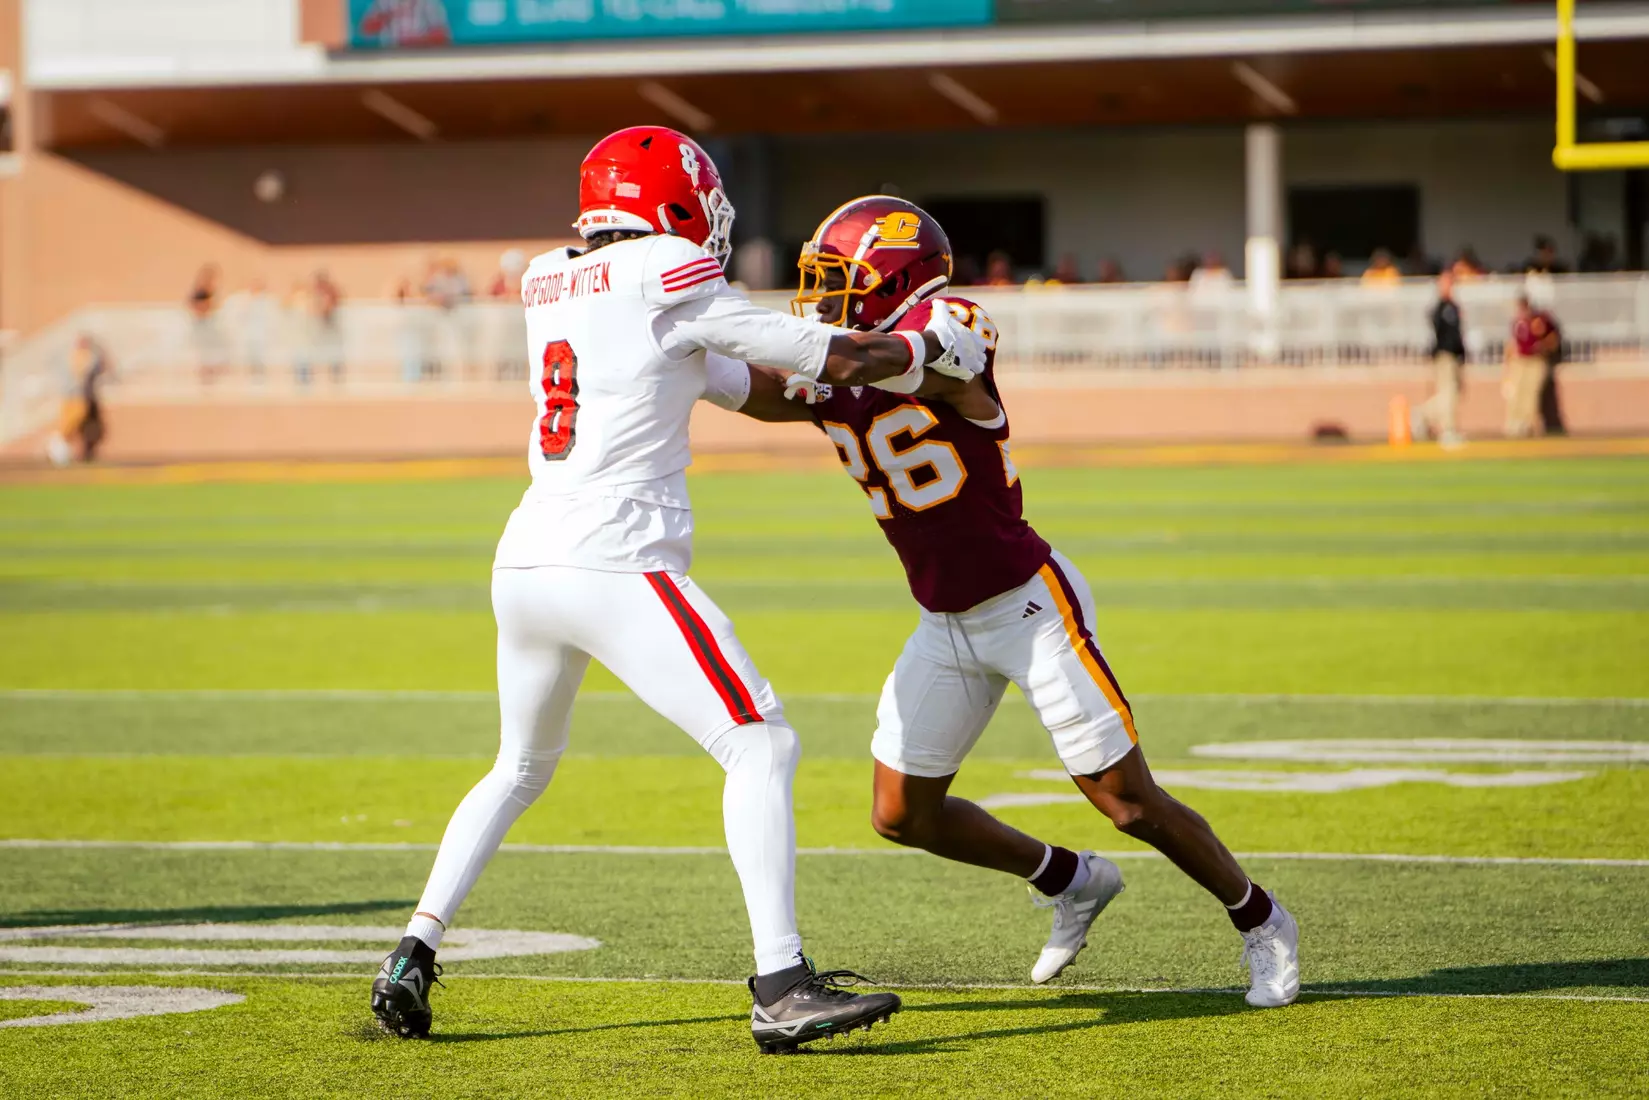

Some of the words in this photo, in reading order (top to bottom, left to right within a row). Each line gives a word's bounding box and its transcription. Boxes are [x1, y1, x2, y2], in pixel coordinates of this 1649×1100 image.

[679, 144, 697, 175] 8
[539, 338, 580, 461] 8
[822, 403, 968, 520] 26
[389, 956, 409, 984] CADDIX
